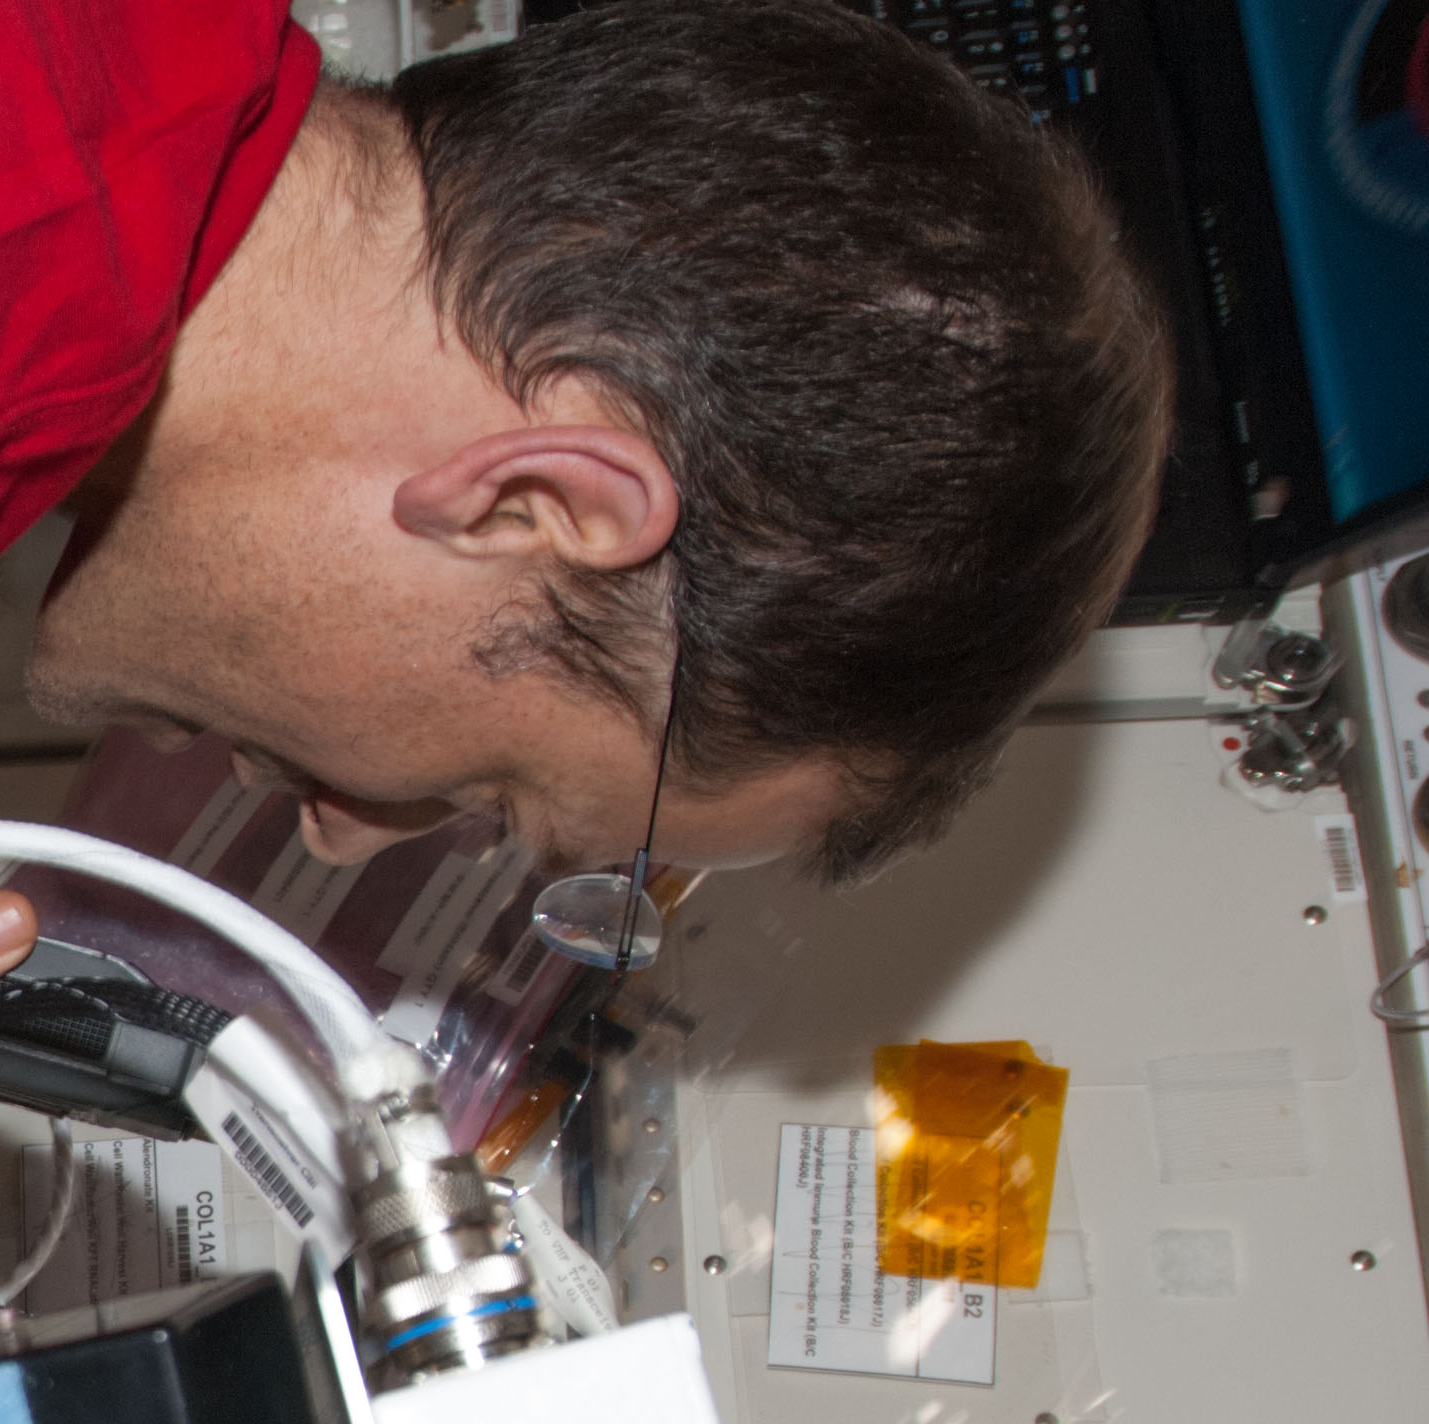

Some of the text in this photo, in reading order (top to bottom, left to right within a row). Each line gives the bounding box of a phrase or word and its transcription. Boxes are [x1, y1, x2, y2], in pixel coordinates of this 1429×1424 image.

[113, 1140, 127, 1160] Cell
[847, 1129, 859, 1160] Blood
[844, 1162, 857, 1217] Collection
[803, 1126, 827, 1357] Integrated Immune Blood Collection Kit (B/C
[843, 1219, 854, 1235] Kit
[841, 1237, 853, 1261] (B/C
[569, 1266, 612, 1334] Transceiv
